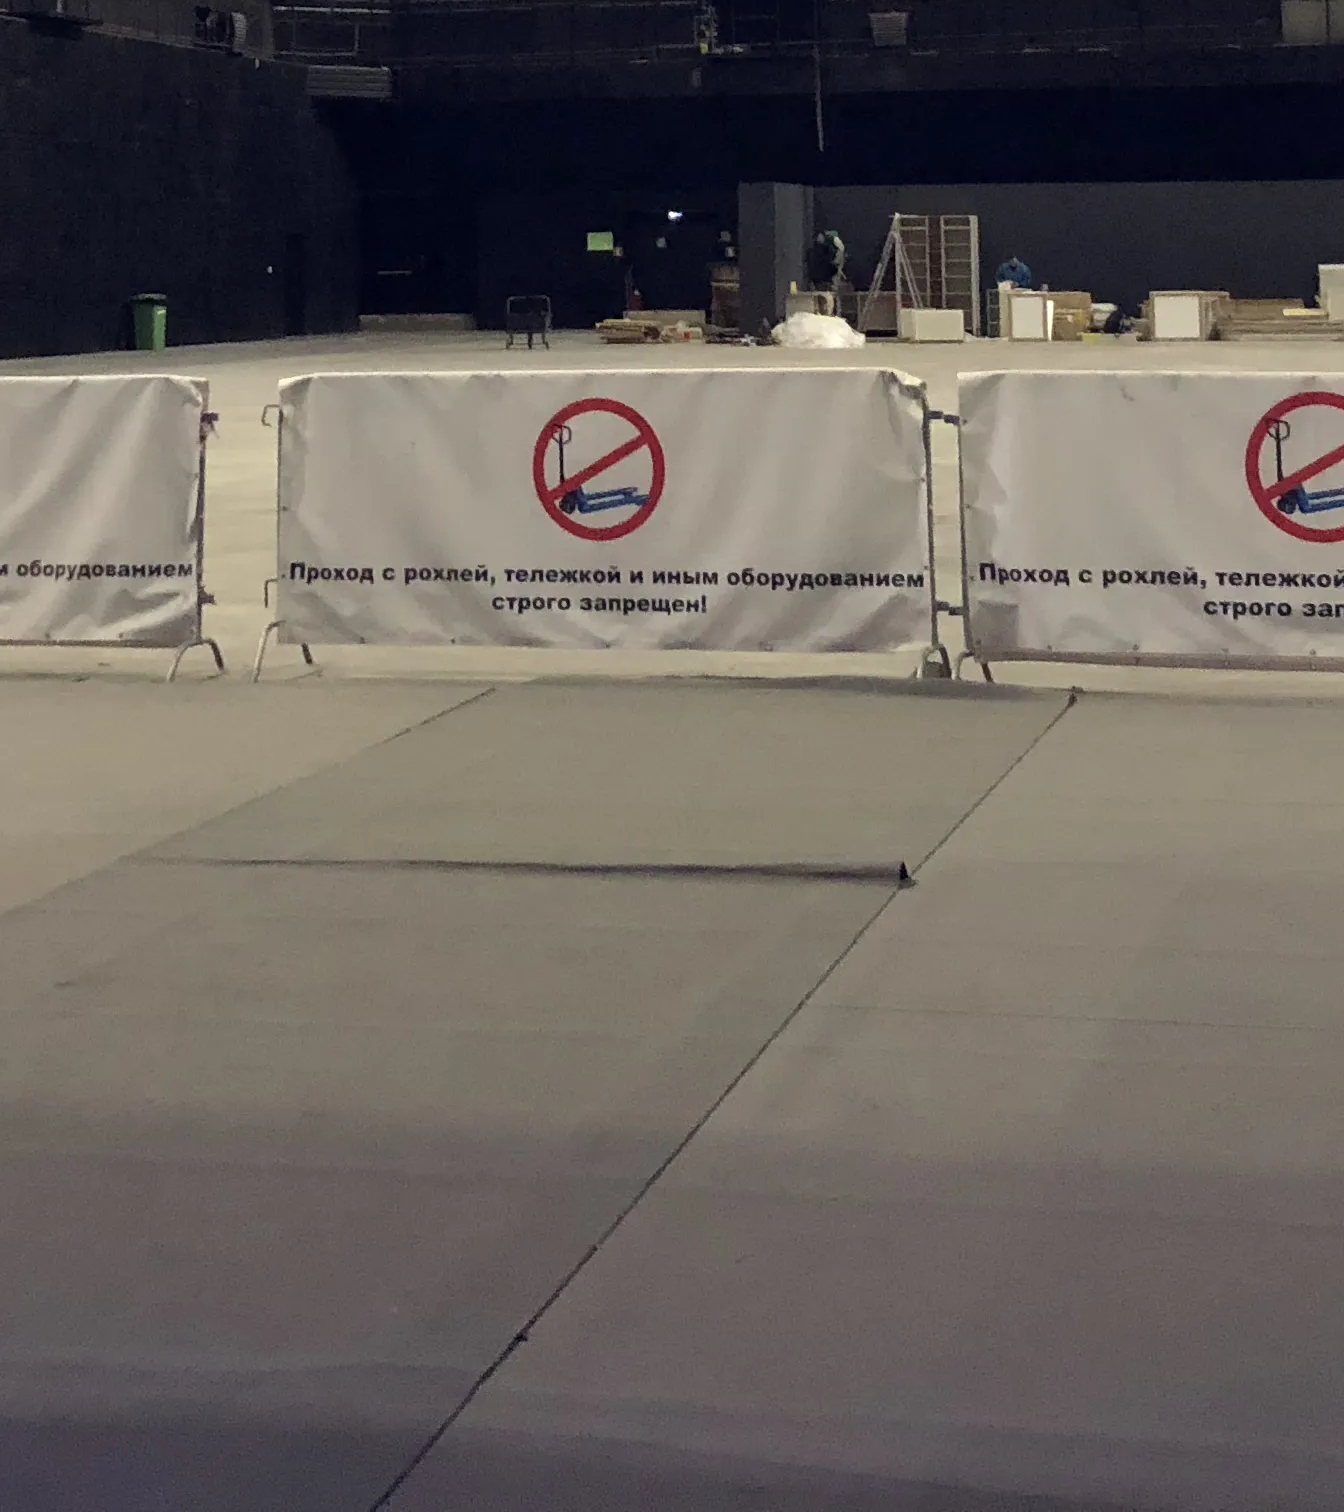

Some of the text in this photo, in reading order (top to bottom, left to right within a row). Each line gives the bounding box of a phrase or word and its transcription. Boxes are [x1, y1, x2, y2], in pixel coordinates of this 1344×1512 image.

[16, 559, 194, 581] оборудованием
[289, 562, 925, 591] Проход с рохлей, тележкой и иным оборудованием
[979, 562, 1070, 586] Проход
[1078, 568, 1093, 584] с
[1102, 566, 1208, 589] рохлей,
[492, 594, 708, 616] строго запрещен!
[1203, 599, 1292, 620] строго
